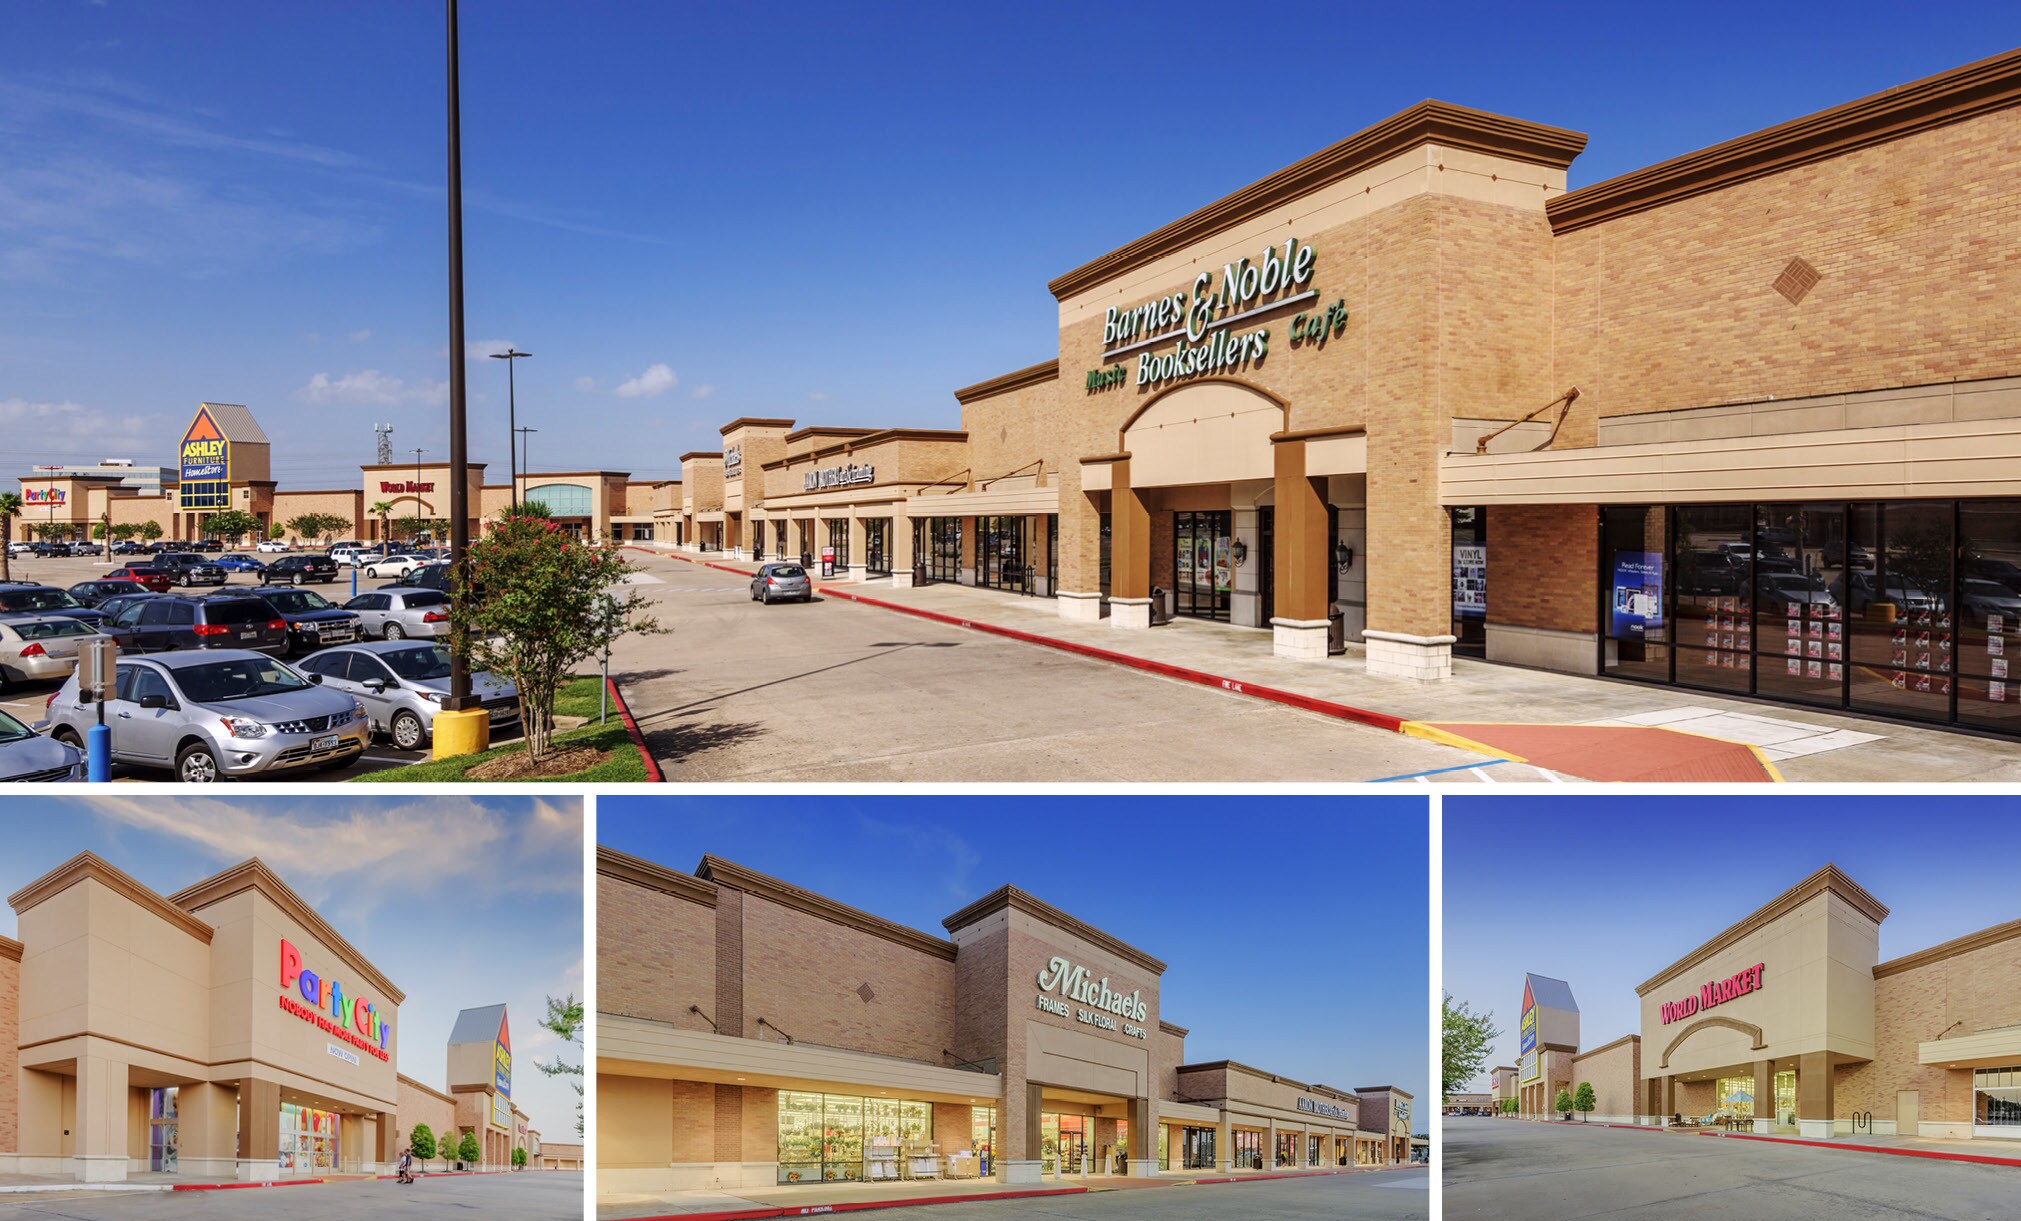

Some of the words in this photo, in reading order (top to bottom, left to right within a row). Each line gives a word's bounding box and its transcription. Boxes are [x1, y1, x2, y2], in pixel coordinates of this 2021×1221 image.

[1102, 292, 1188, 346] Barnes
[1186, 272, 1214, 342] &
[1216, 237, 1317, 310] Noble
[1136, 328, 1270, 386] Booksellers
[1085, 363, 1127, 390] Music
[182, 440, 226, 457] ASHLEY
[183, 455, 225, 464] FURNITURE
[184, 465, 223, 478] HomeStore
[1460, 549, 1482, 560] VINYL
[1621, 561, 1634, 569] Read
[1635, 563, 1655, 571] Forever
[1037, 956, 1147, 1023] Michaels
[1660, 995, 1699, 1026] WORLD
[1700, 962, 1765, 1011] MARKET
[279, 995, 315, 1025] NOBODY
[316, 1016, 333, 1034] HAS
[331, 1025, 352, 1044] MORE
[351, 1033, 369, 1052] PARTY
[1037, 994, 1070, 1017] FRAMES
[1077, 1008, 1094, 1025] SILK
[1094, 1014, 1117, 1032] FLORAL
[1123, 1022, 1147, 1040] CRAFTS
